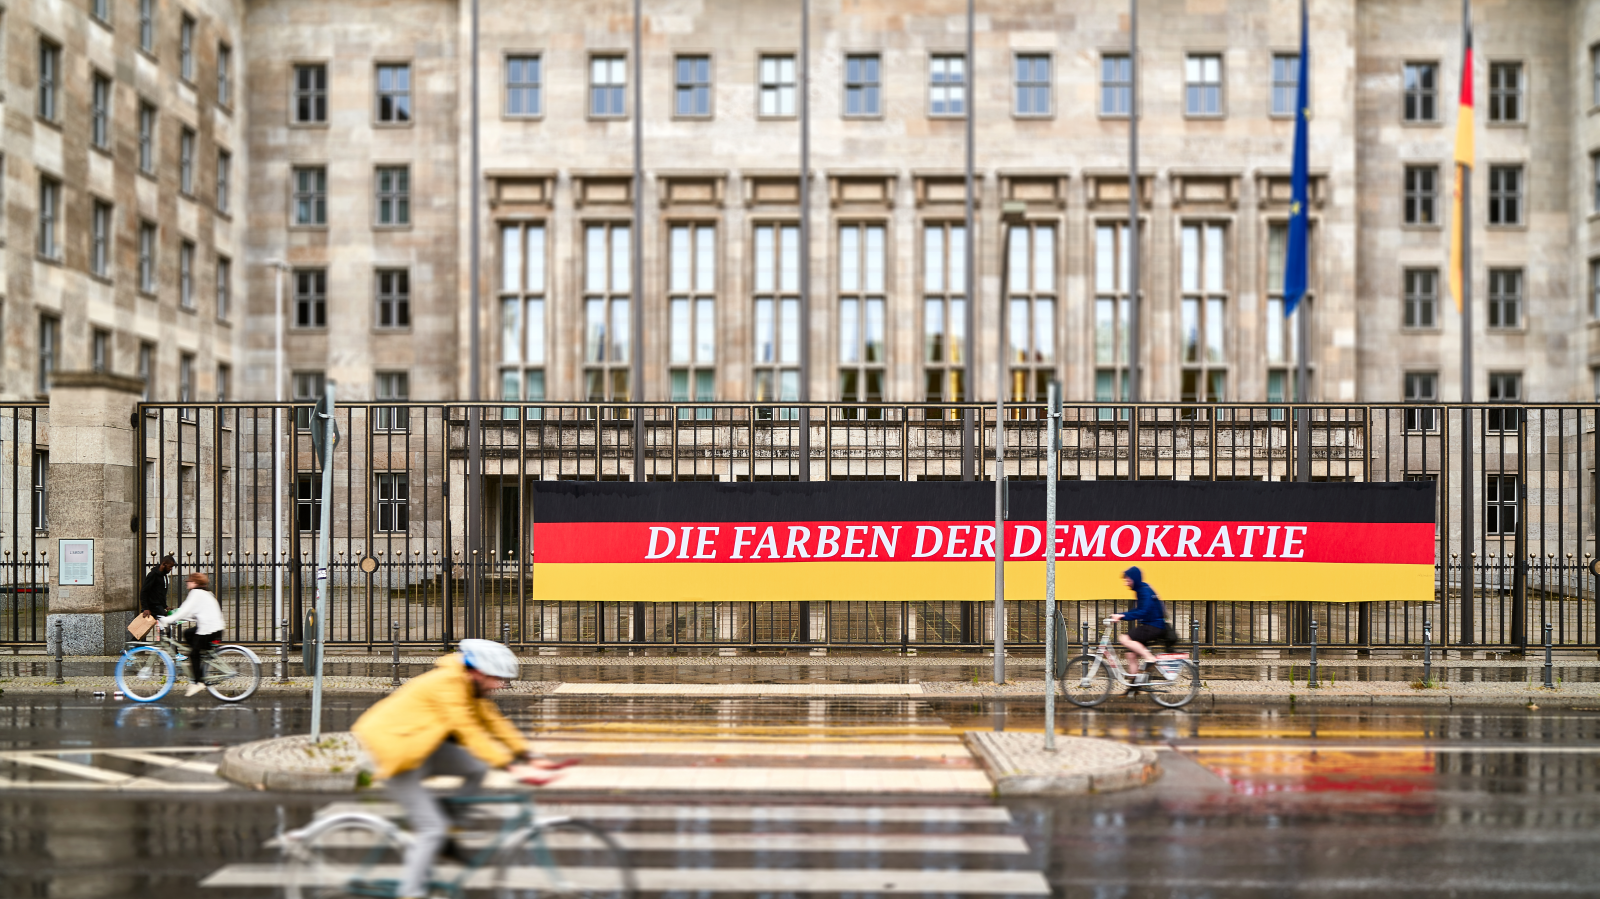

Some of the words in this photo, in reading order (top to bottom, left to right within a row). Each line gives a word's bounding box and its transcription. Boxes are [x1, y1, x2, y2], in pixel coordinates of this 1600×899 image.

[644, 526, 720, 560] DIE
[729, 525, 903, 559] FARBEN
[911, 525, 996, 558] DER
[1009, 524, 1308, 559] DEMOKRATIE
